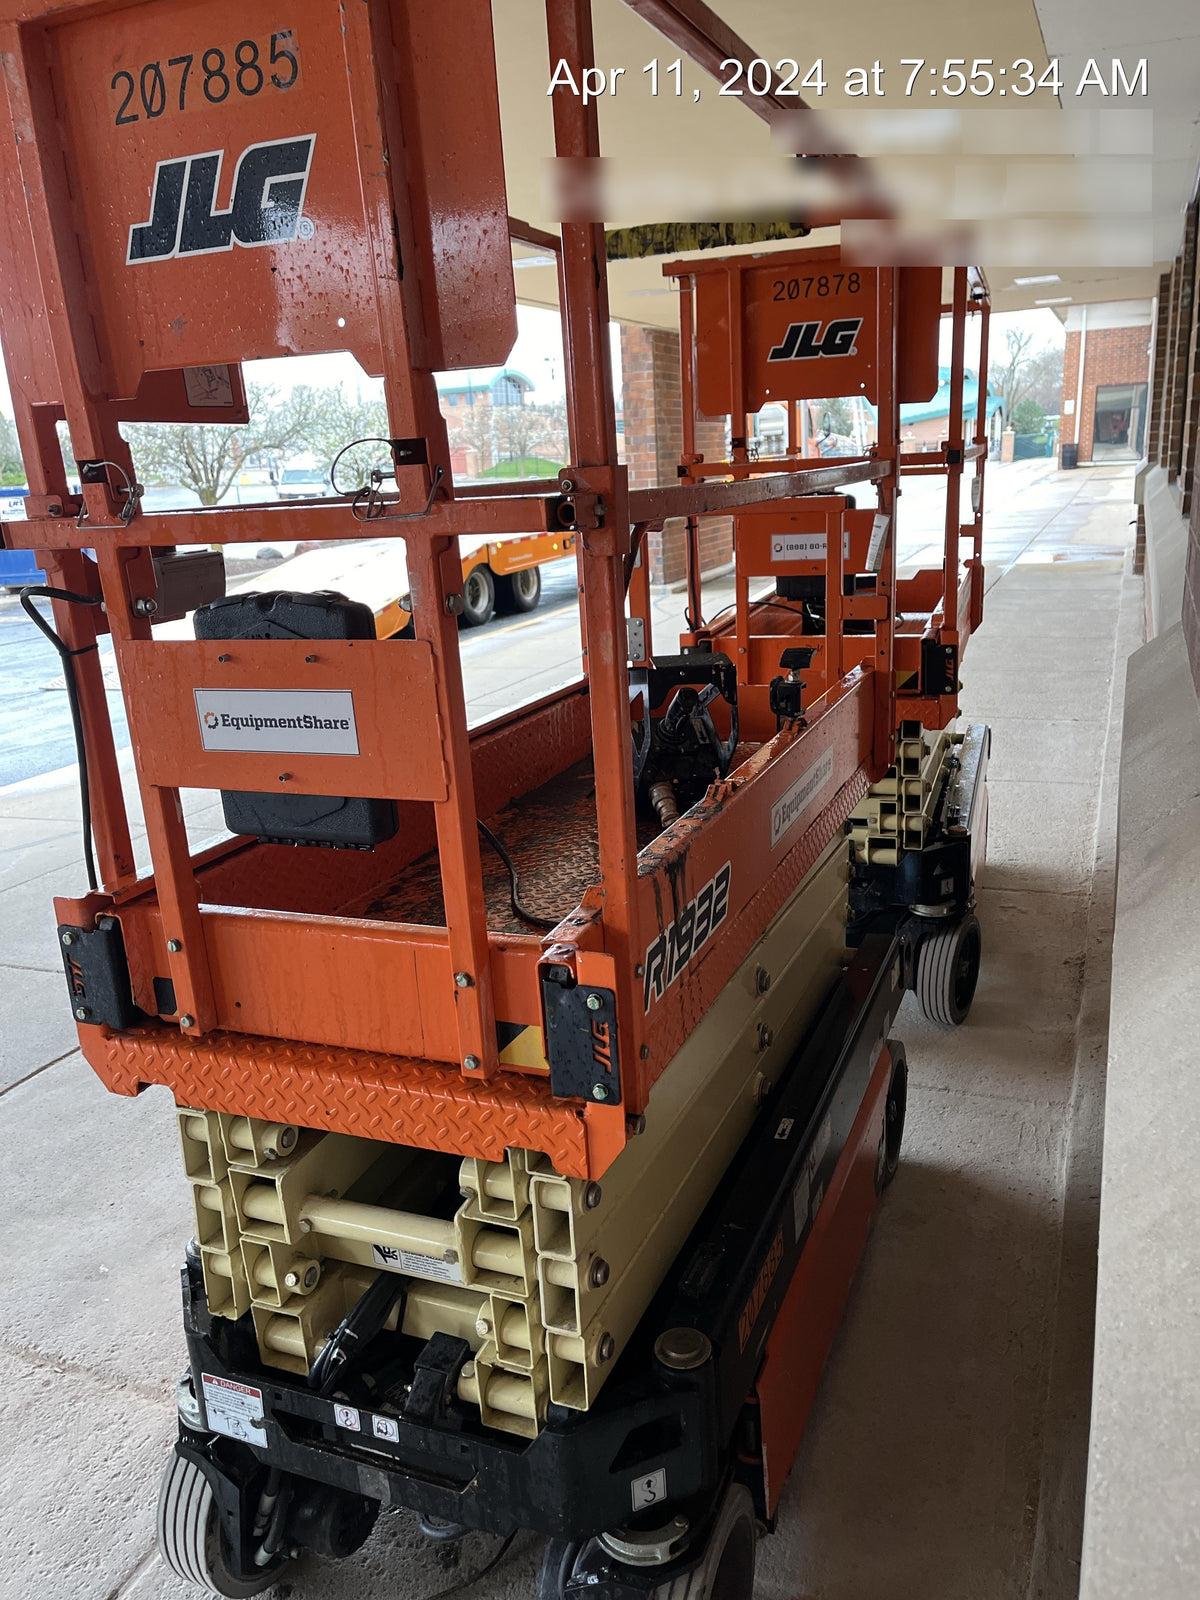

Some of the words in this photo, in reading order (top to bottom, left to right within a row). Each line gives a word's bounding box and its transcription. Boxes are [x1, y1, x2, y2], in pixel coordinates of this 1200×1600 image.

[111, 30, 298, 126] 207885
[773, 272, 861, 302] 207878
[220, 713, 350, 730] EquipmentShare
[592, 1019, 613, 1074] JLG
[220, 1380, 252, 1394] DANGER
